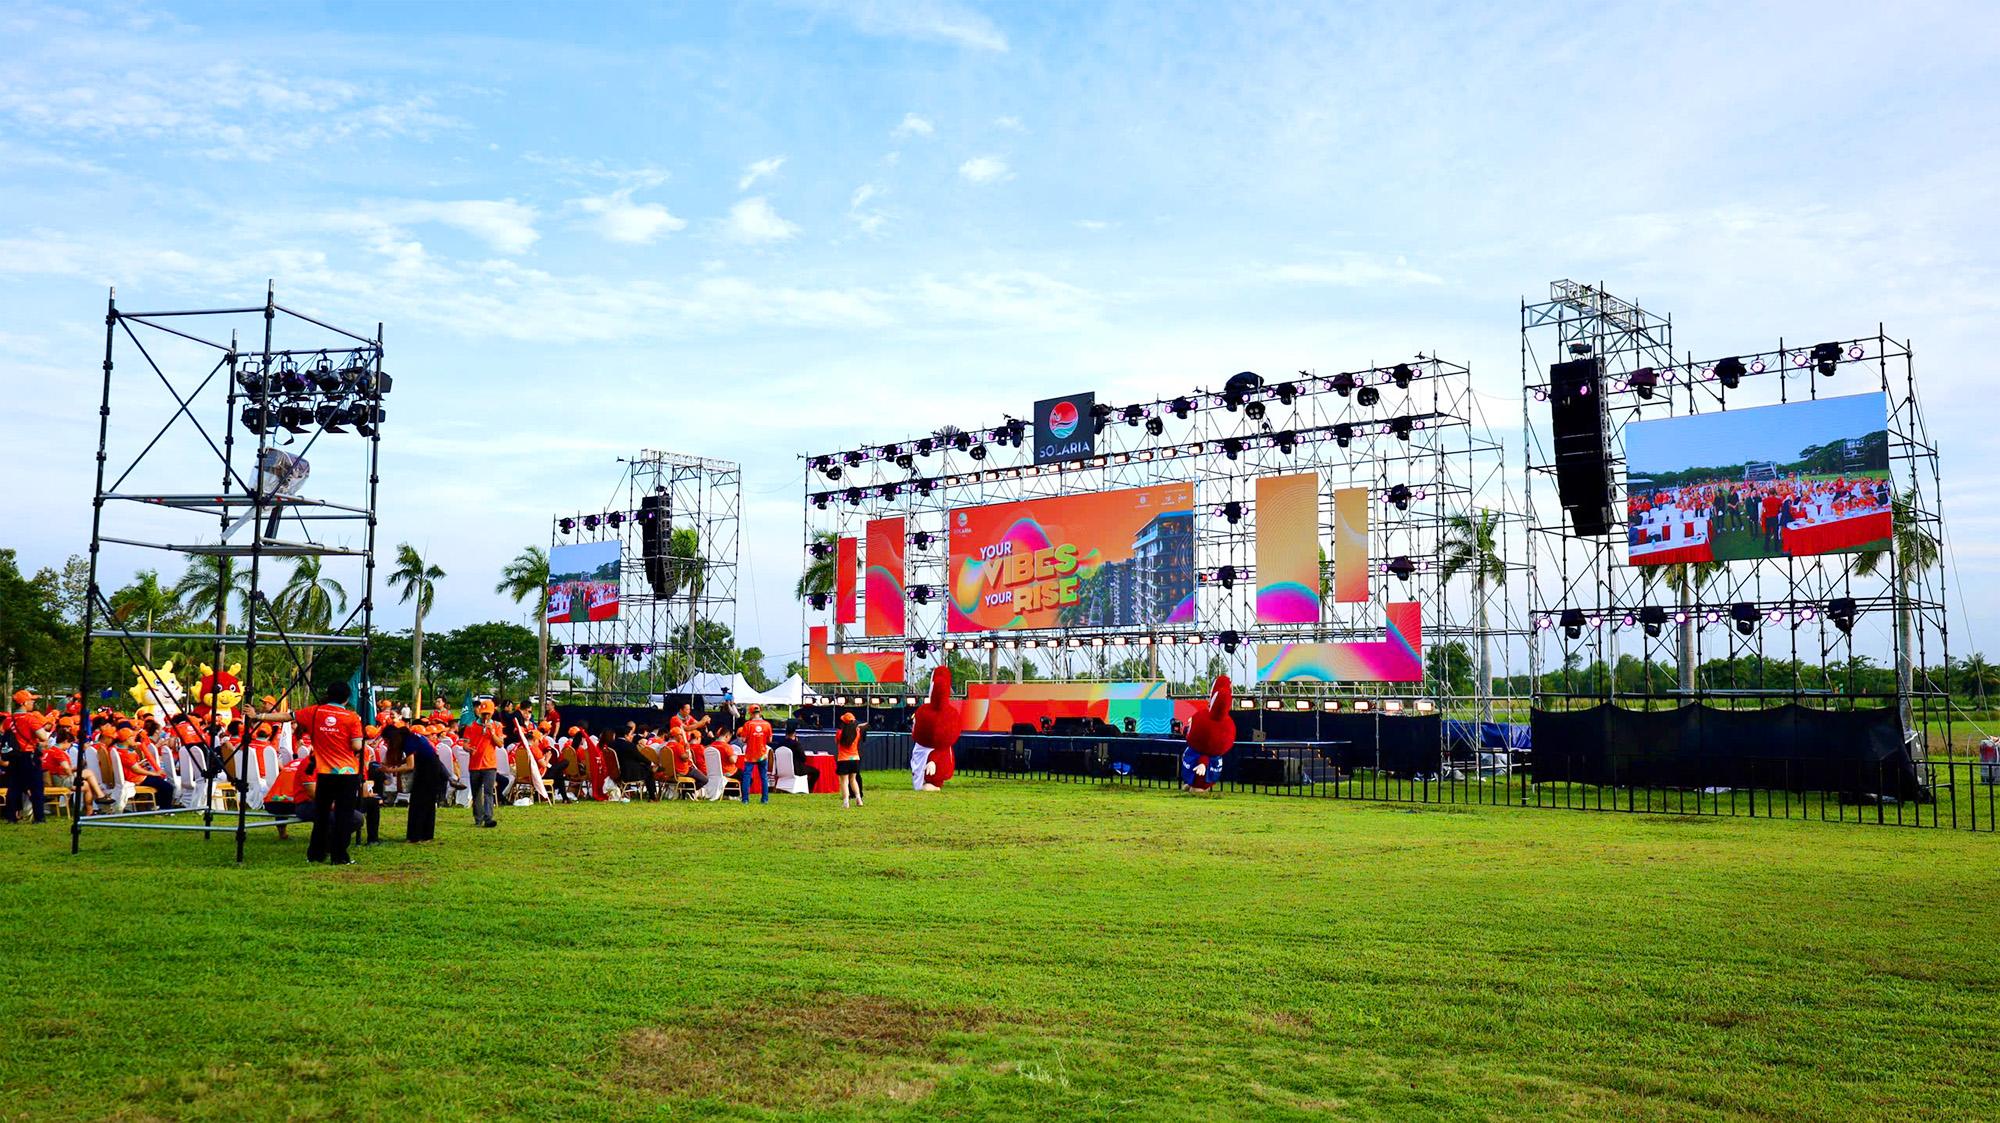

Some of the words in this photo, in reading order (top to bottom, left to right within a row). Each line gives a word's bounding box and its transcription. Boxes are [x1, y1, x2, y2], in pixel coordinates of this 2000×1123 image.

[1039, 441, 1090, 458] SOLARIA
[980, 541, 1012, 560] YOUR
[983, 543, 1078, 590] VIBES
[984, 591, 1012, 607] YOUR
[1013, 576, 1079, 614] RISE
